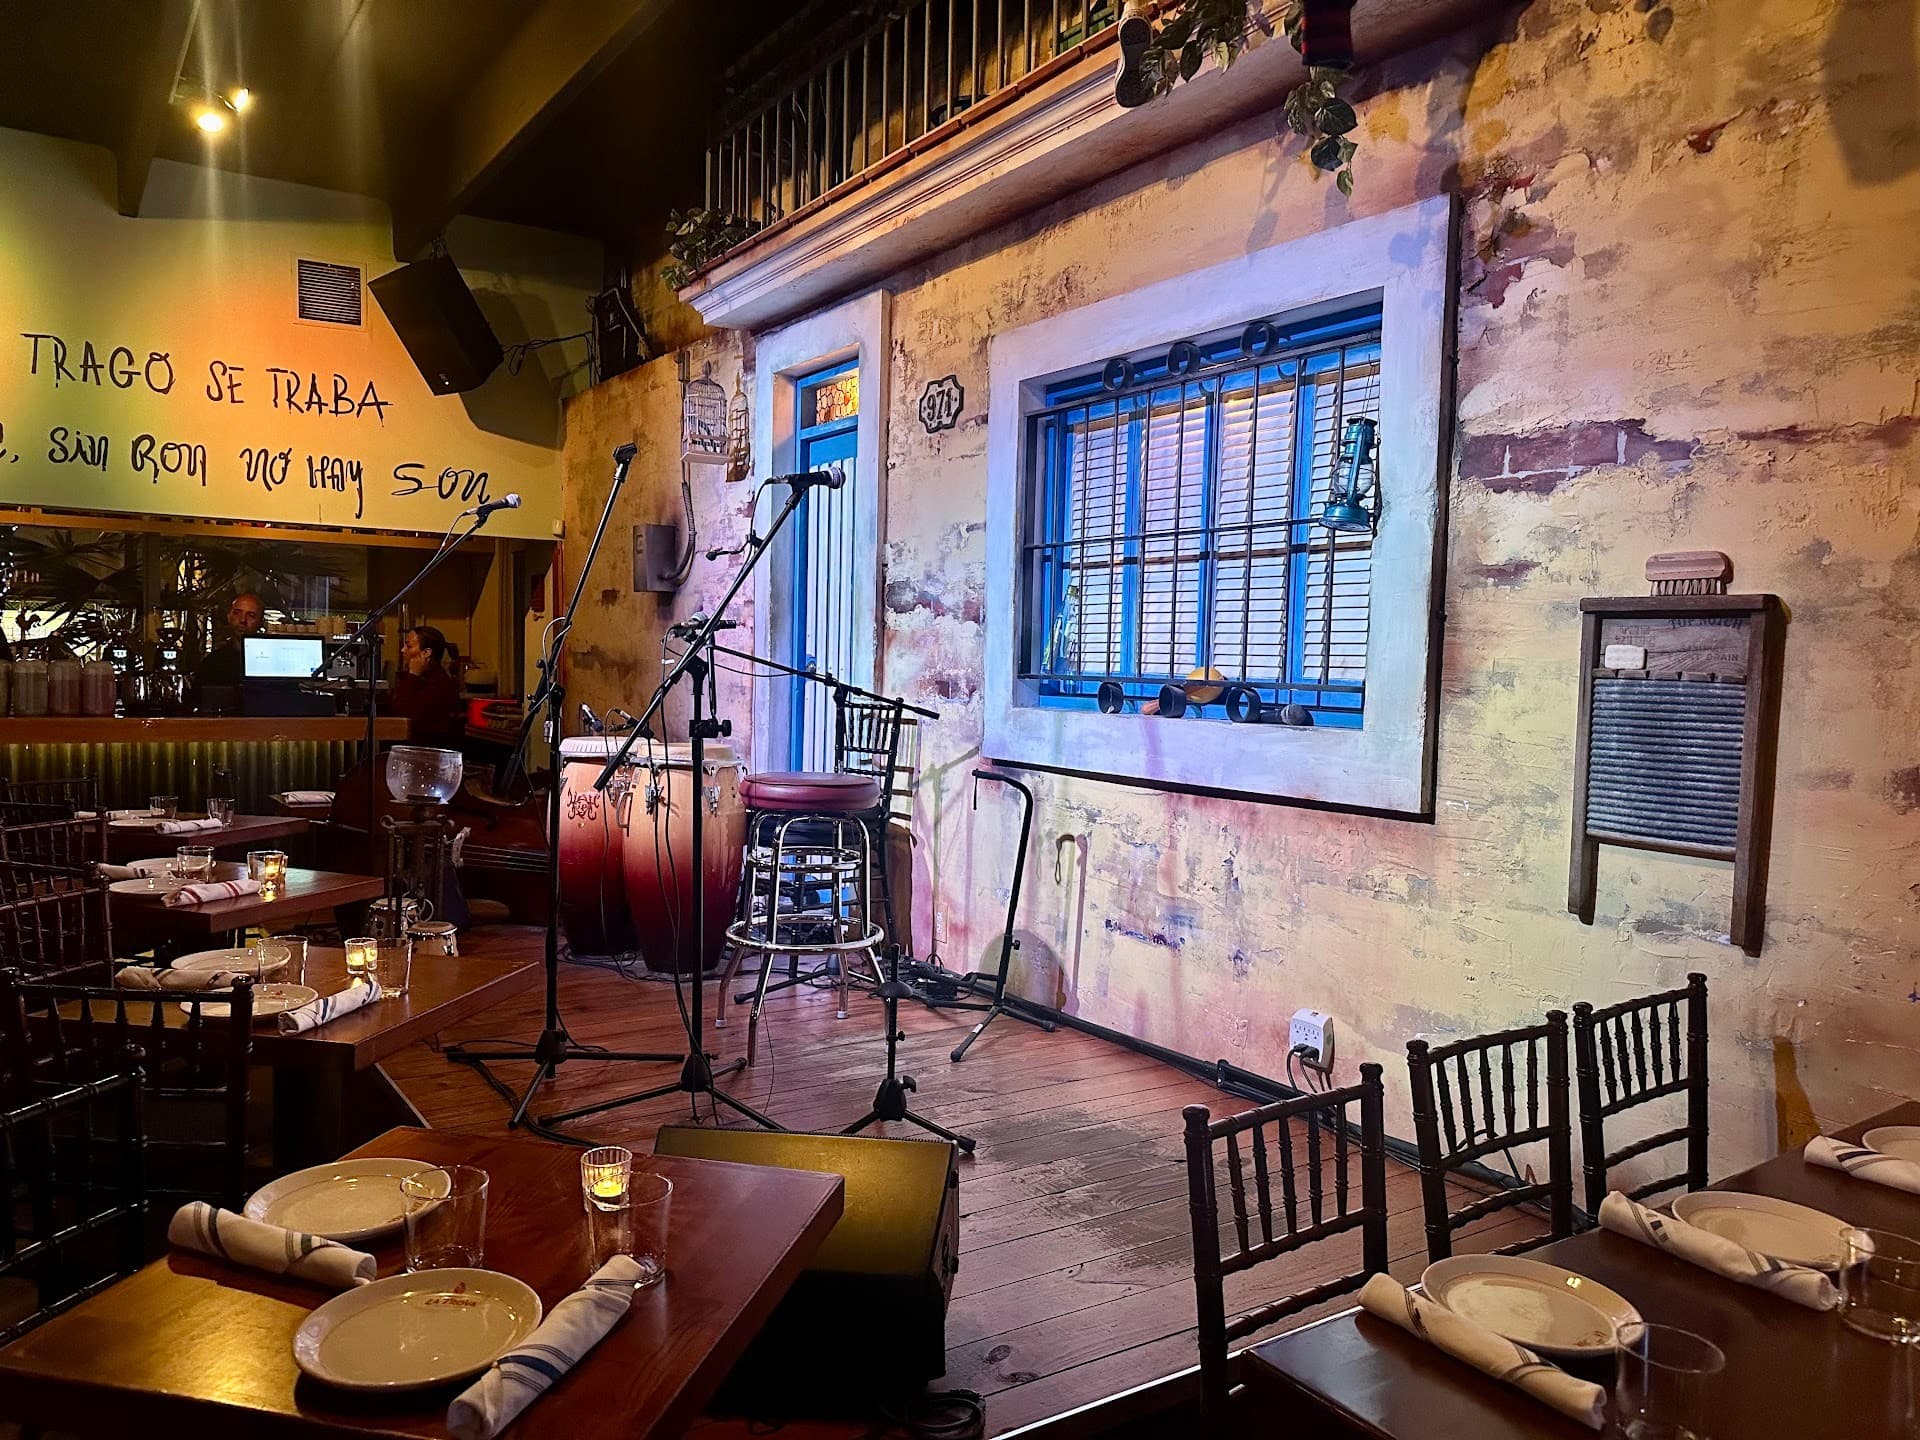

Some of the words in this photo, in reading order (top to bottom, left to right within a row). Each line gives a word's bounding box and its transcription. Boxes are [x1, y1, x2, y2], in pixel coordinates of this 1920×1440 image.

[20, 333, 176, 395] TRAGO
[206, 360, 245, 404] SE
[265, 368, 394, 428] TRABA
[927, 388, 952, 421] 971
